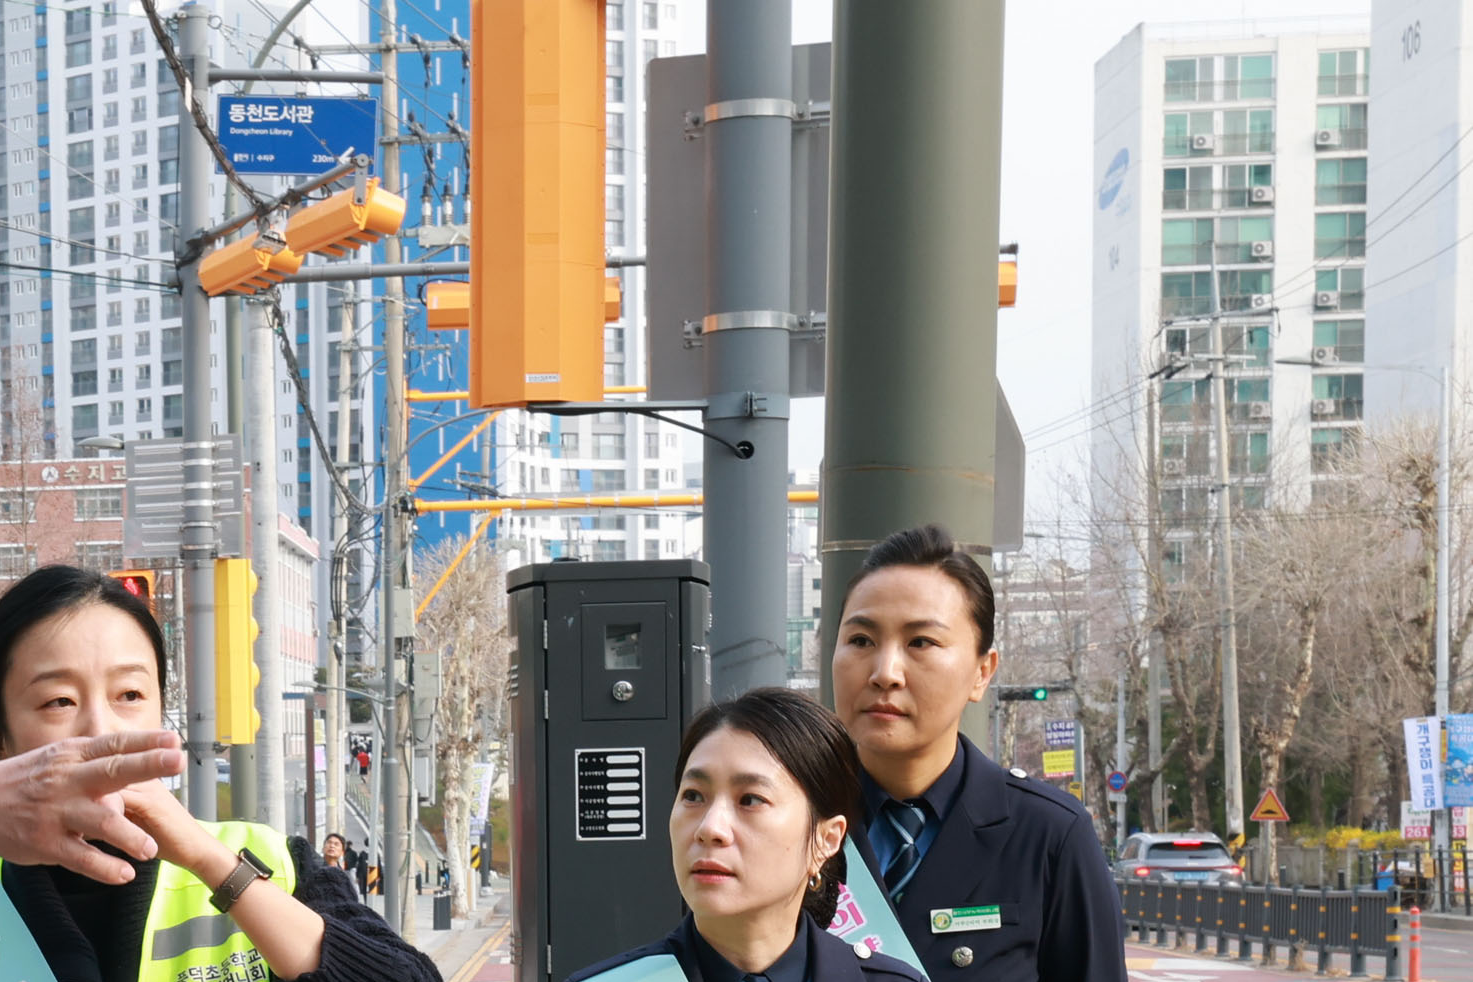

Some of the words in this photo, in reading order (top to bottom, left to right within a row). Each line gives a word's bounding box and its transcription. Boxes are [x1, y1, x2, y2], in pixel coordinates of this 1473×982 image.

[1401, 19, 1420, 63] 106
[229, 104, 314, 124] 동천도서관
[230, 127, 268, 136] Dongcheon
[270, 128, 294, 137] Library
[312, 154, 335, 163] 230m
